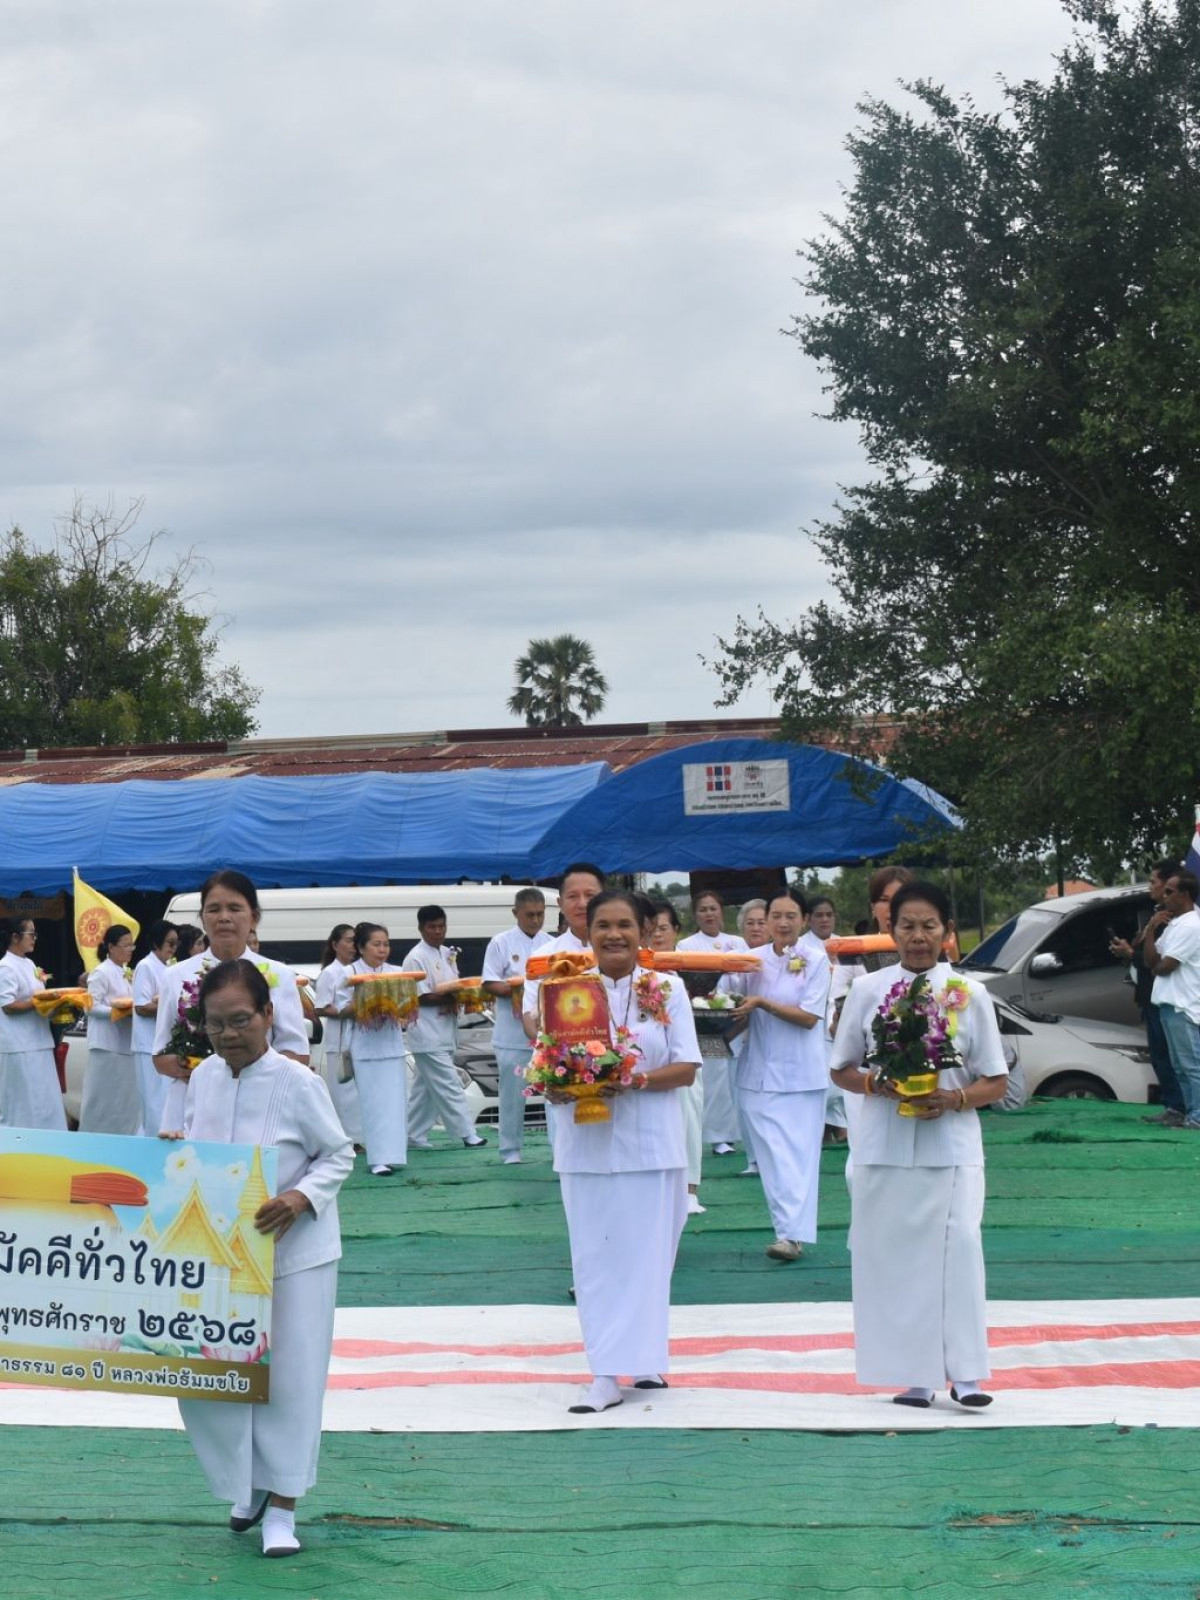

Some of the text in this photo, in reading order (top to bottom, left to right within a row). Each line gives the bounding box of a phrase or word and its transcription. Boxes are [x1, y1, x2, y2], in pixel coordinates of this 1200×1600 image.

[138, 1309, 257, 1346] ๒๕๖๘
[61, 1363, 86, 1378] ๘๑
[92, 1359, 105, 1379] ปี
[111, 1366, 249, 1391] หลวงพ่อธัมมชโย
